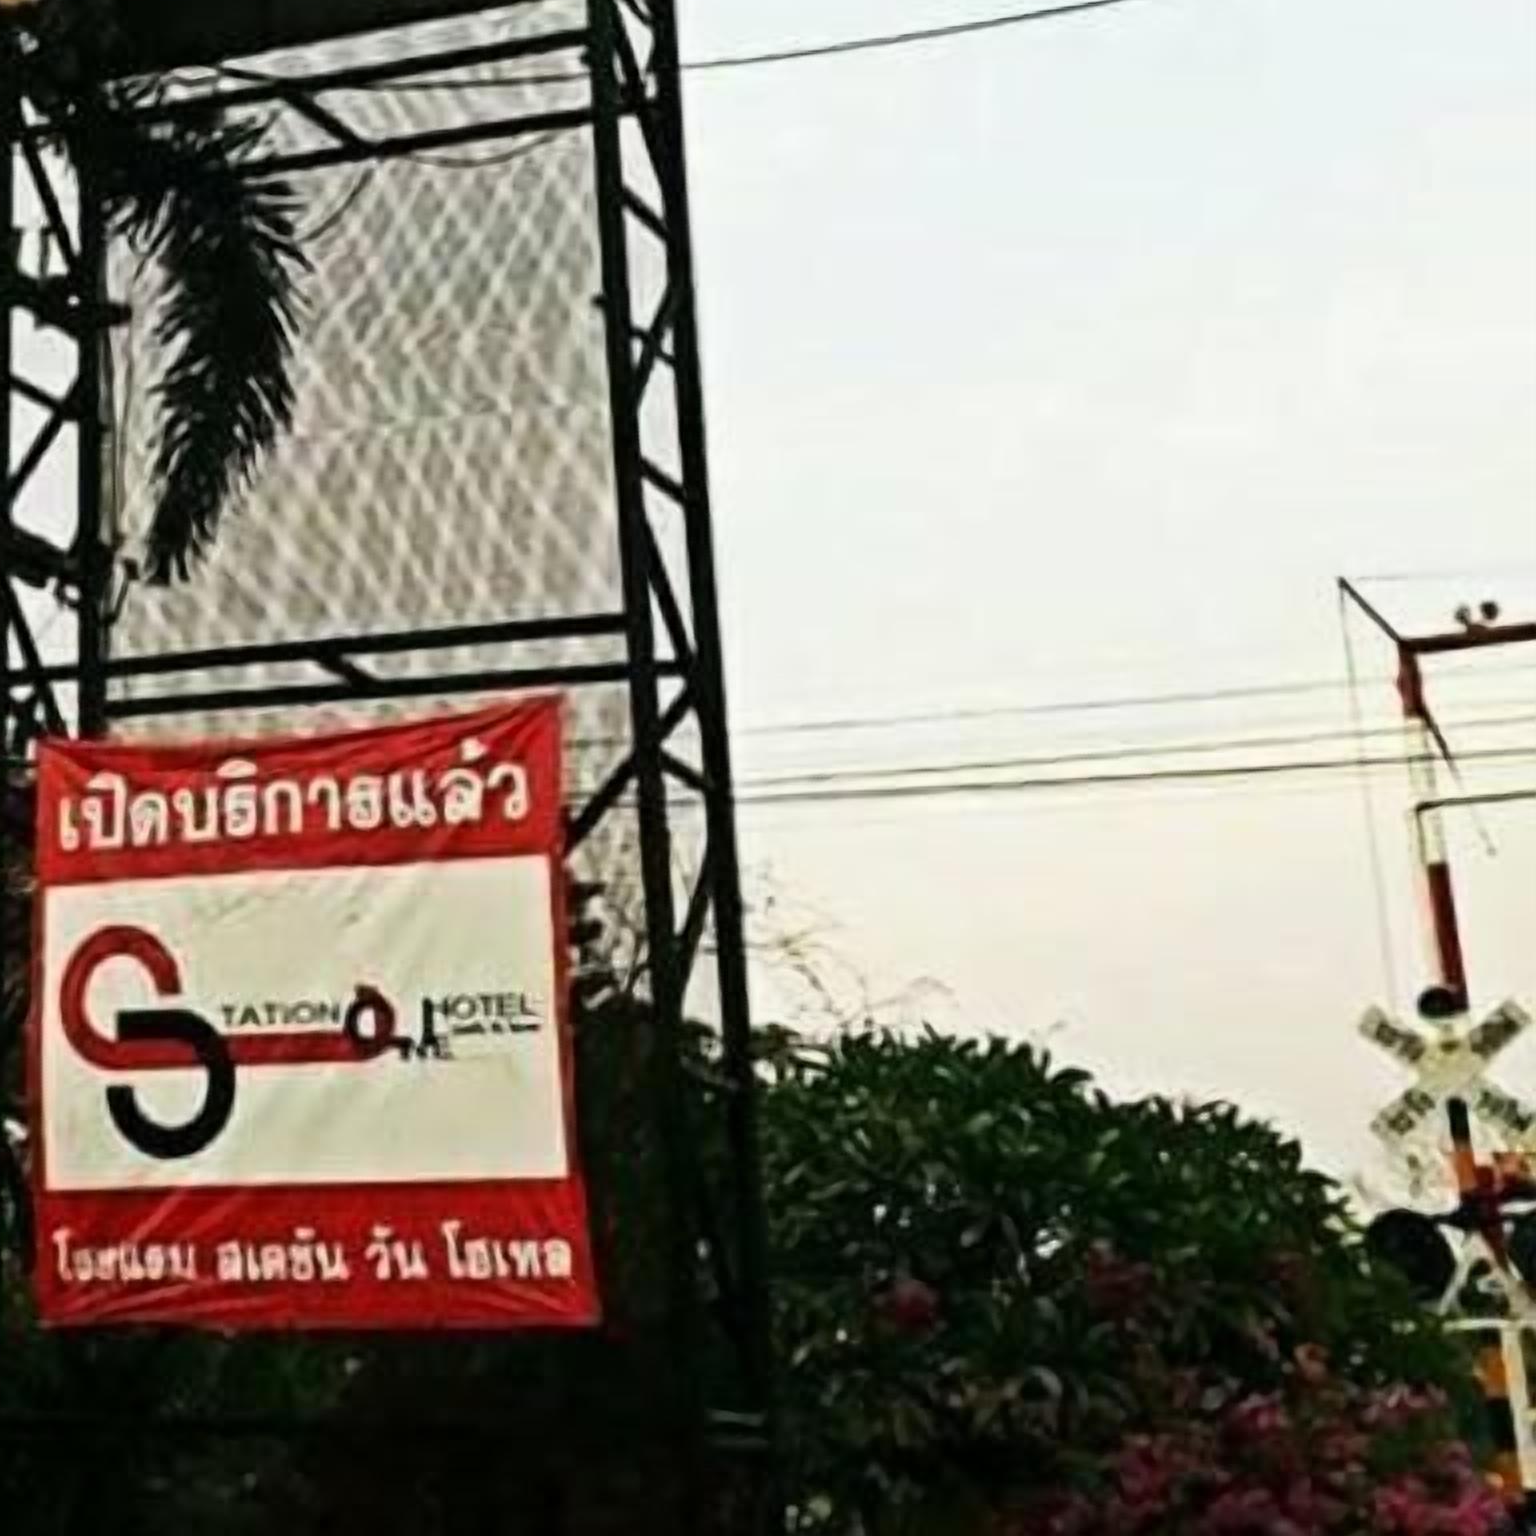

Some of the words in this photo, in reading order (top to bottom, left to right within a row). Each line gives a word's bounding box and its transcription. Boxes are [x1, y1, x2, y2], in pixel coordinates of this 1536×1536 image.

[58, 737, 530, 851] เปิดบริการแล้ว
[421, 991, 538, 1042] HOTEL
[365, 1224, 430, 1281] วัน
